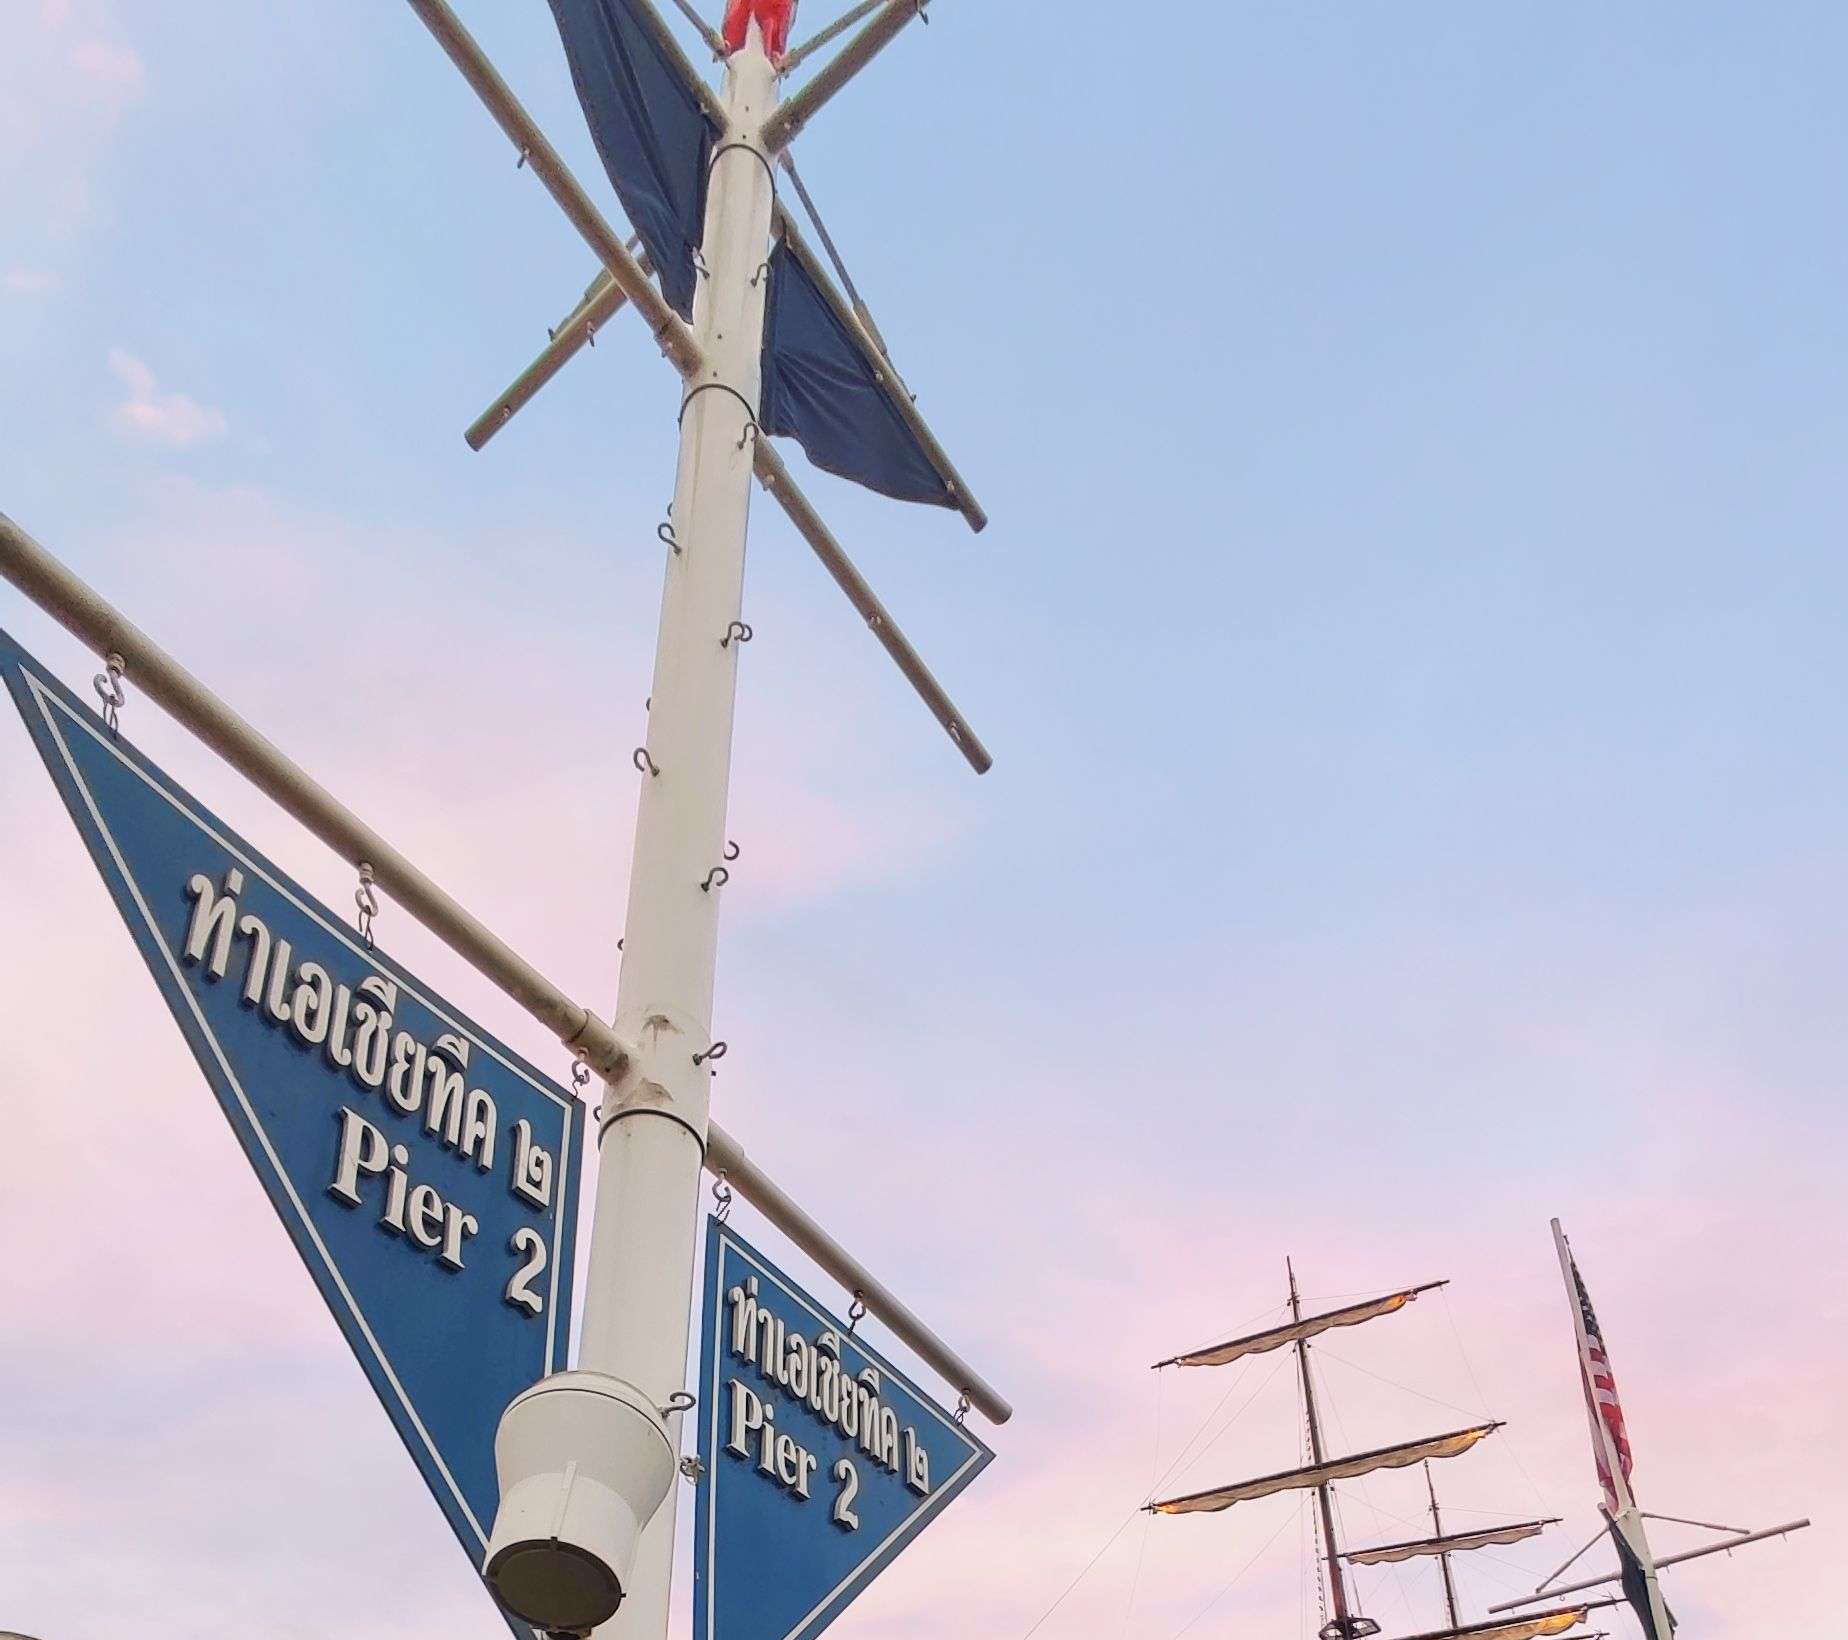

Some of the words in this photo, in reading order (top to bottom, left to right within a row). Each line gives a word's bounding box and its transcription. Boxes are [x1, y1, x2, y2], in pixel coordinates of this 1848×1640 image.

[183, 867, 497, 1176] ท่าเอเชียทีค
[512, 1118, 553, 1213] ๒
[326, 1104, 478, 1271] Pier
[505, 1226, 547, 1317] 2
[726, 1378, 817, 1501] Pier
[833, 1458, 859, 1531] 2
[728, 1275, 899, 1474] ท่าเอเชียทีค
[904, 1426, 931, 1497] ๒
